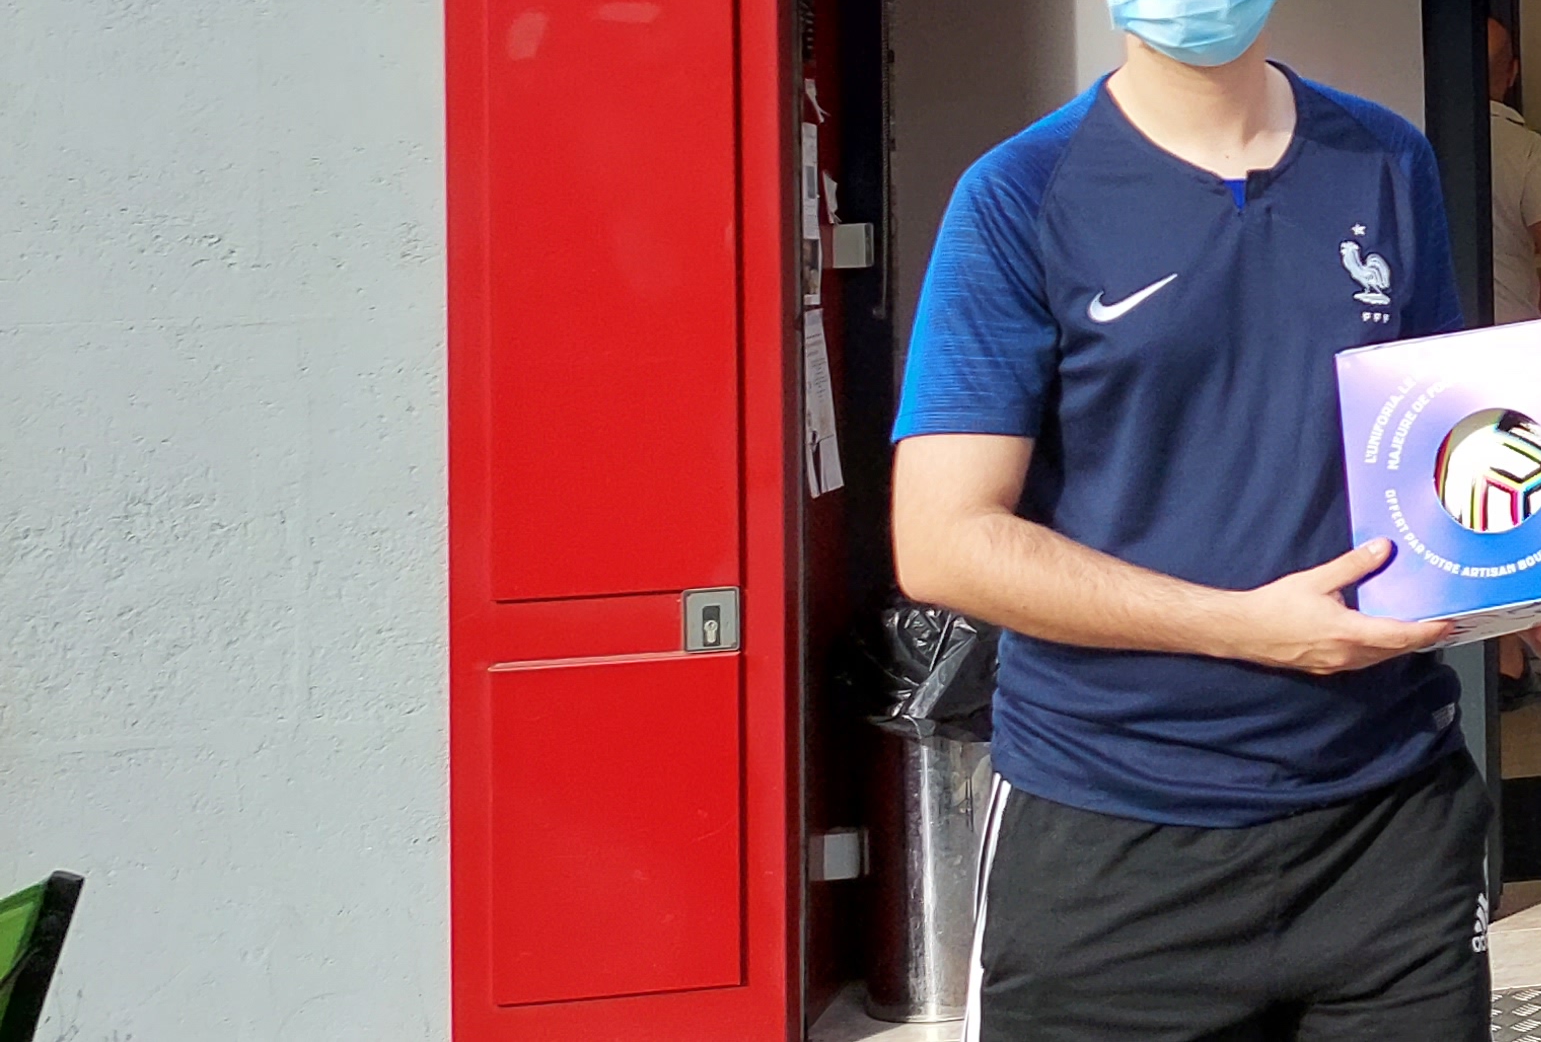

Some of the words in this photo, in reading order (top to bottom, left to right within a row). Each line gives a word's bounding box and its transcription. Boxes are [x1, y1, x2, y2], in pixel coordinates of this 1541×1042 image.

[1385, 489, 1409, 533] OFFERT
[1404, 532, 1425, 555] PAR
[1424, 550, 1461, 575] VOTRE
[1461, 563, 1517, 578] ARTISAN
